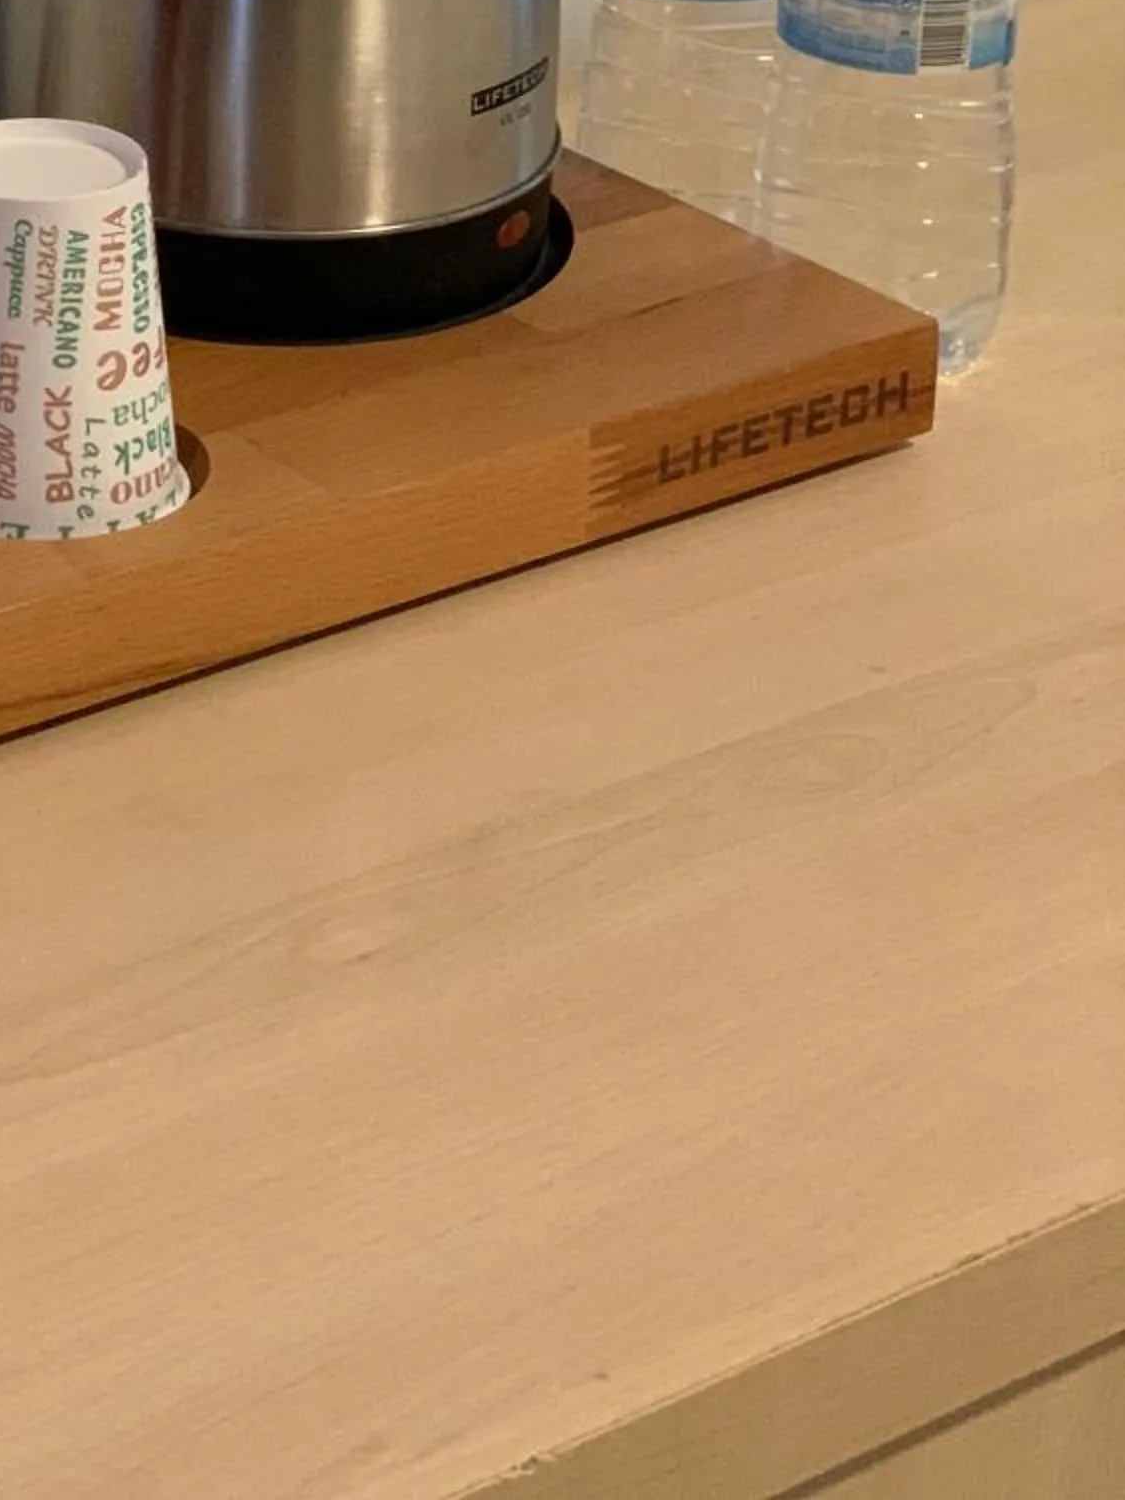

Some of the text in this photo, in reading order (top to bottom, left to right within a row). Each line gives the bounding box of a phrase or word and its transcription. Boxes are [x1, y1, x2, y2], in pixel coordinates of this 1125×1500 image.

[52, 229, 90, 370] AMERICANO
[43, 385, 75, 503] BLACK
[77, 415, 106, 521] Latte
[658, 369, 910, 486] LIFETECH
